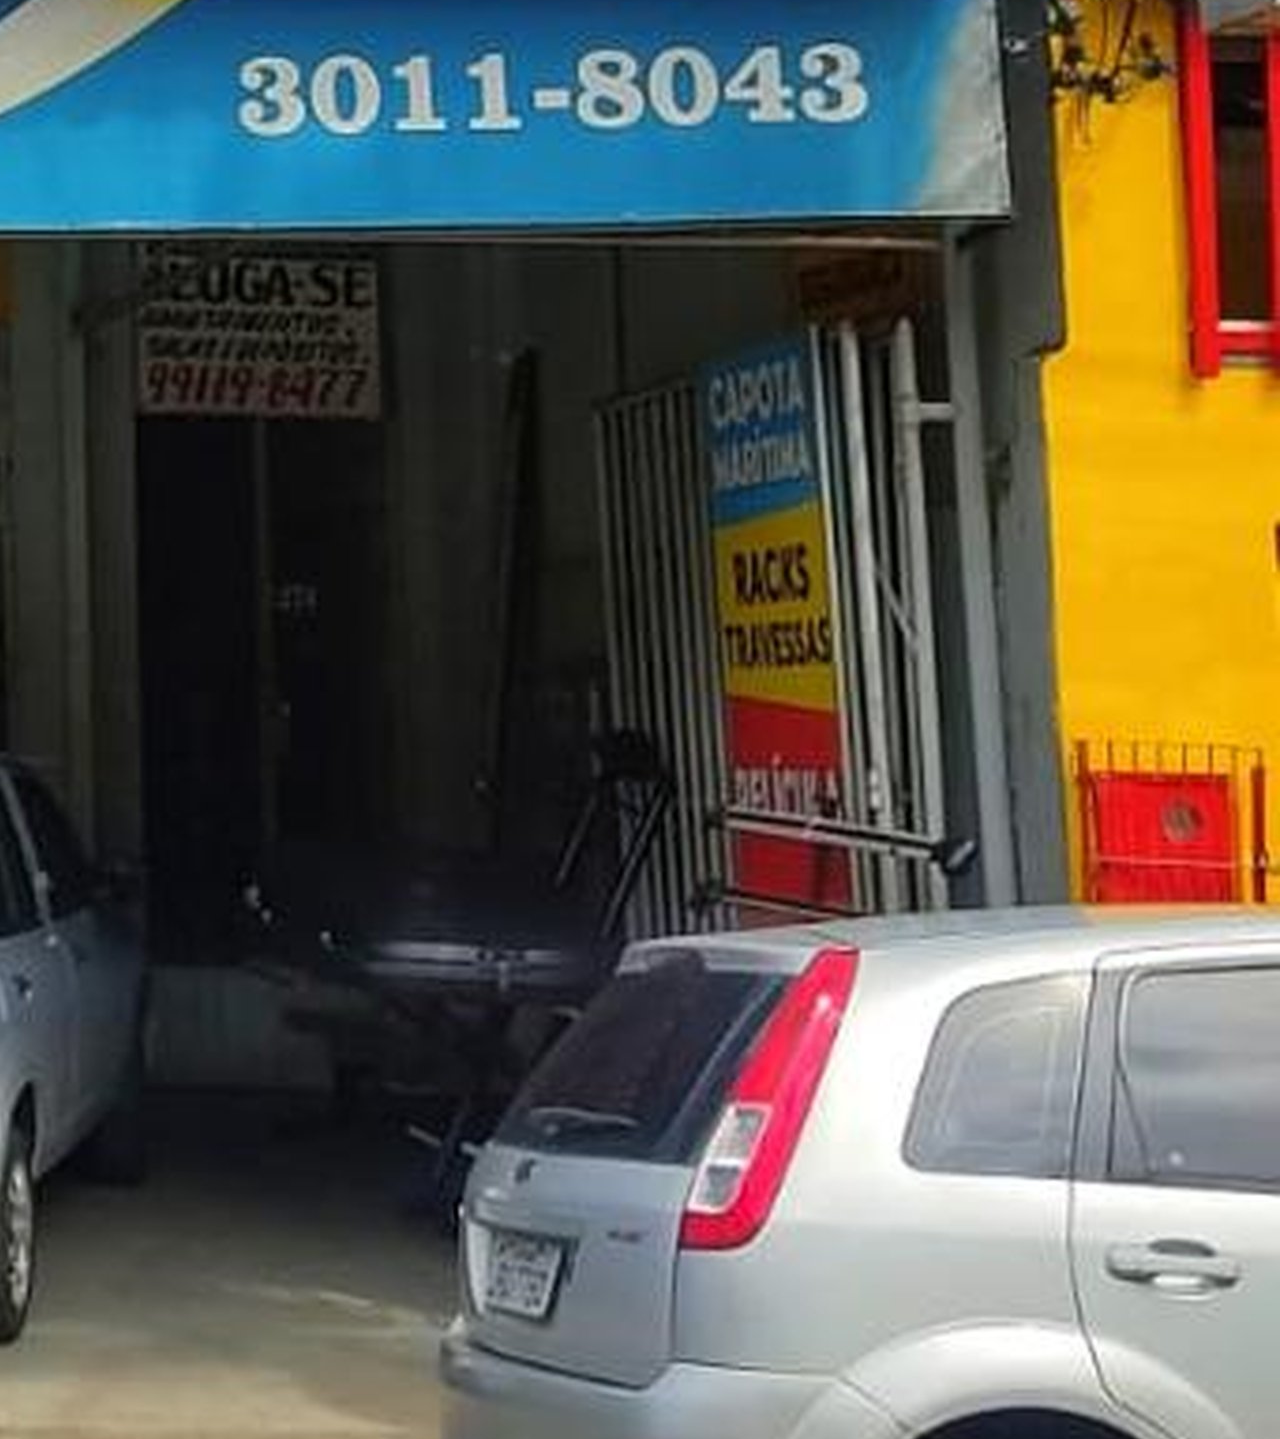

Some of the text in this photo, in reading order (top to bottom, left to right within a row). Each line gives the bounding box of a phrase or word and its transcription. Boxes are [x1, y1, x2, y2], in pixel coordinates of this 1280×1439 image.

[238, 41, 871, 136] 3011-8043
[707, 354, 806, 429] CAPOTA
[731, 541, 812, 603] RACKS
[724, 617, 833, 670] TRAVESSAS
